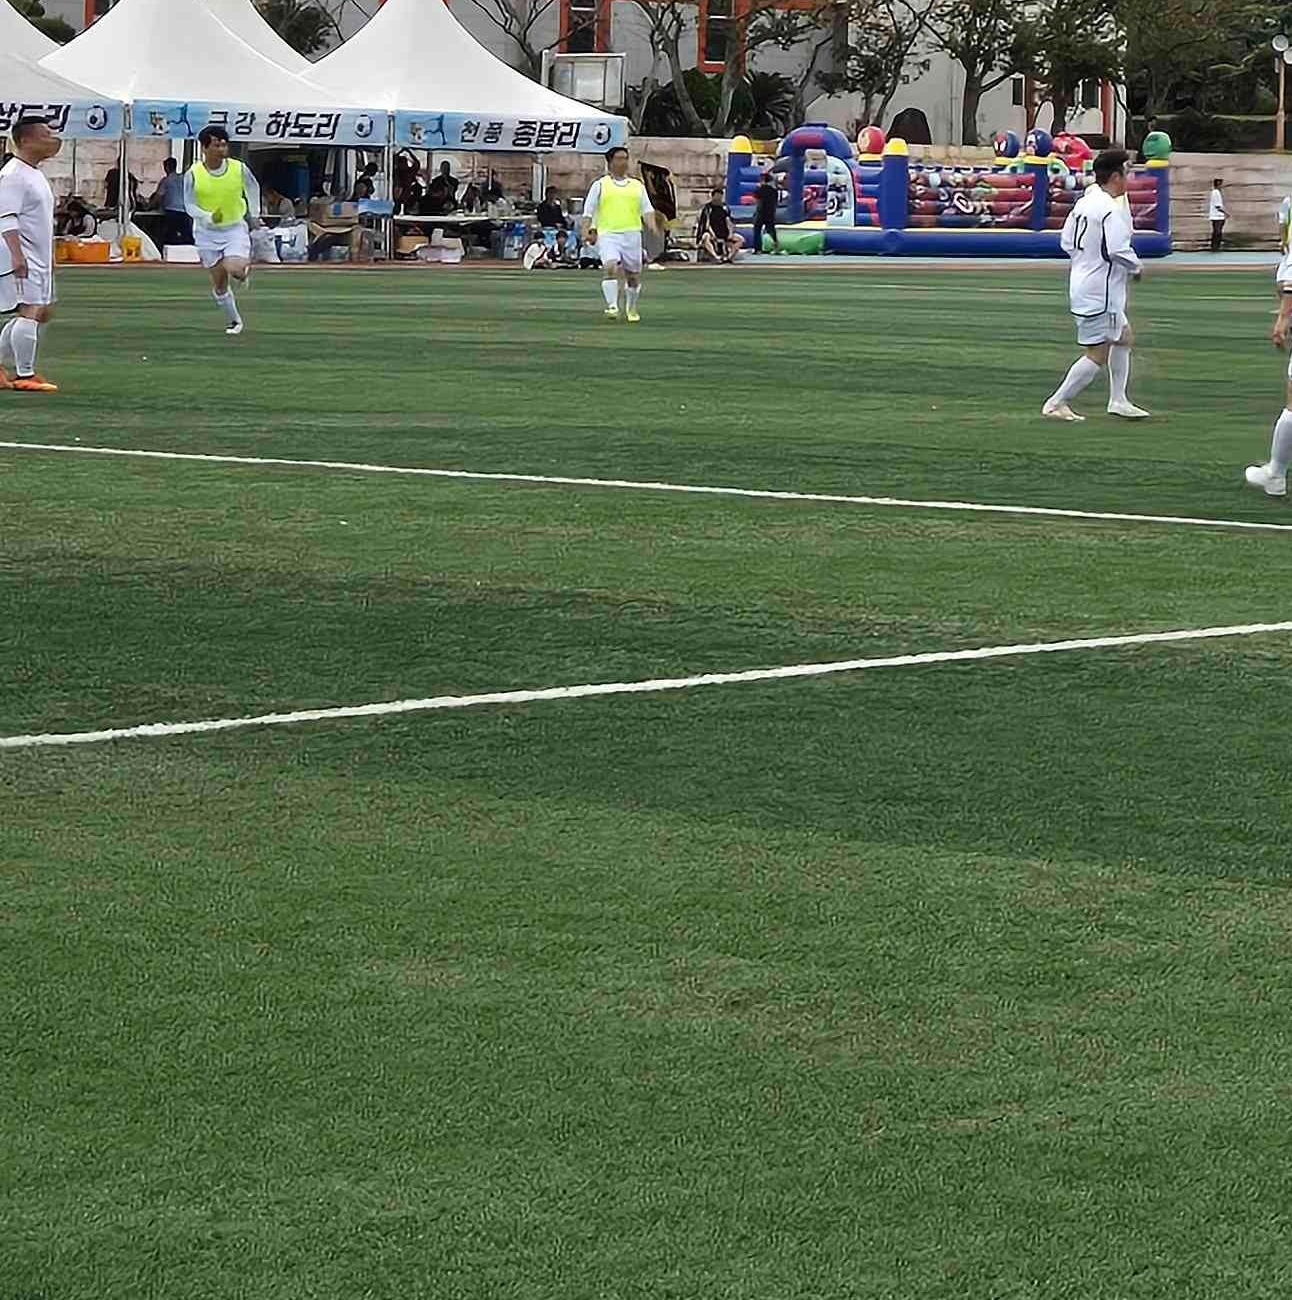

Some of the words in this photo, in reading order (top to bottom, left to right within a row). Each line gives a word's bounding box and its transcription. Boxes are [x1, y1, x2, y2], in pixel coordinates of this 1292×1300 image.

[265, 110, 342, 140] 하도리
[511, 120, 581, 148] 종달리
[1073, 214, 1088, 252] 12
